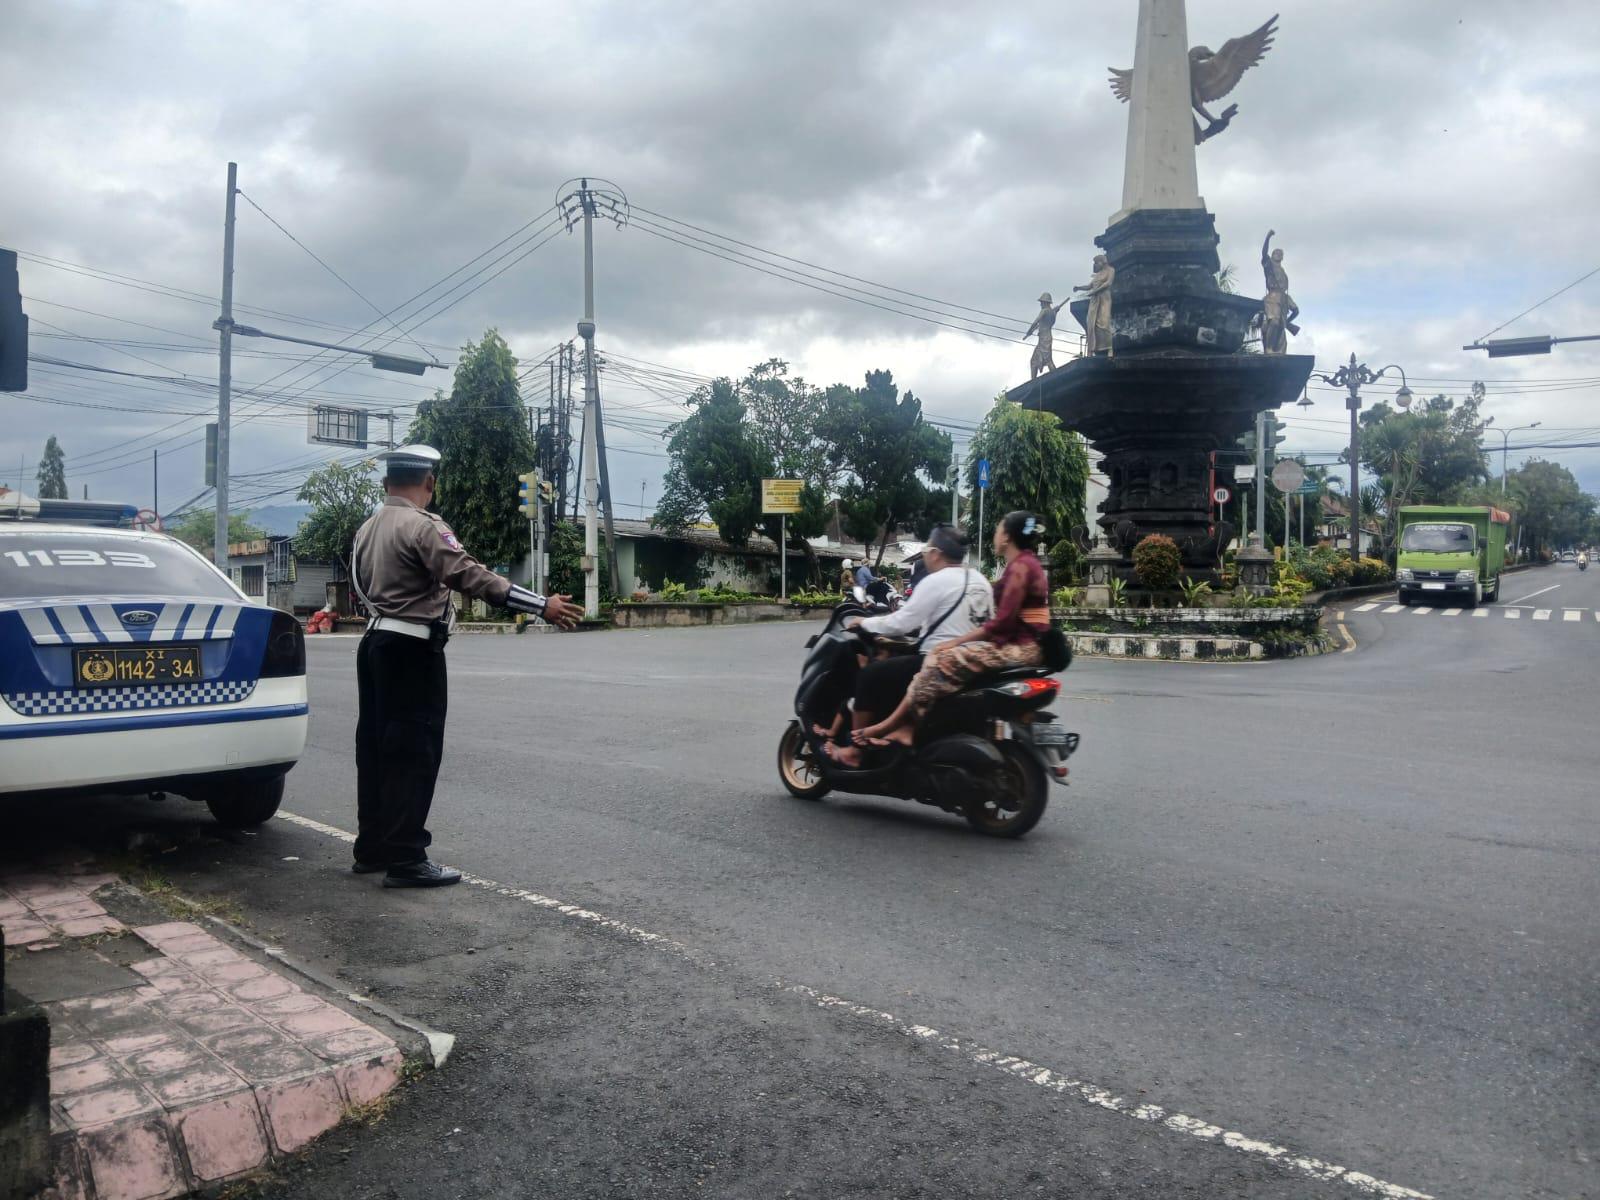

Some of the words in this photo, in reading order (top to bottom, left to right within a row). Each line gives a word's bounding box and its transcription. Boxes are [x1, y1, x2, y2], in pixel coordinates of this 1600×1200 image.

[3, 549, 156, 568] 1133
[117, 660, 156, 680] 1142
[172, 659, 194, 678] 34
